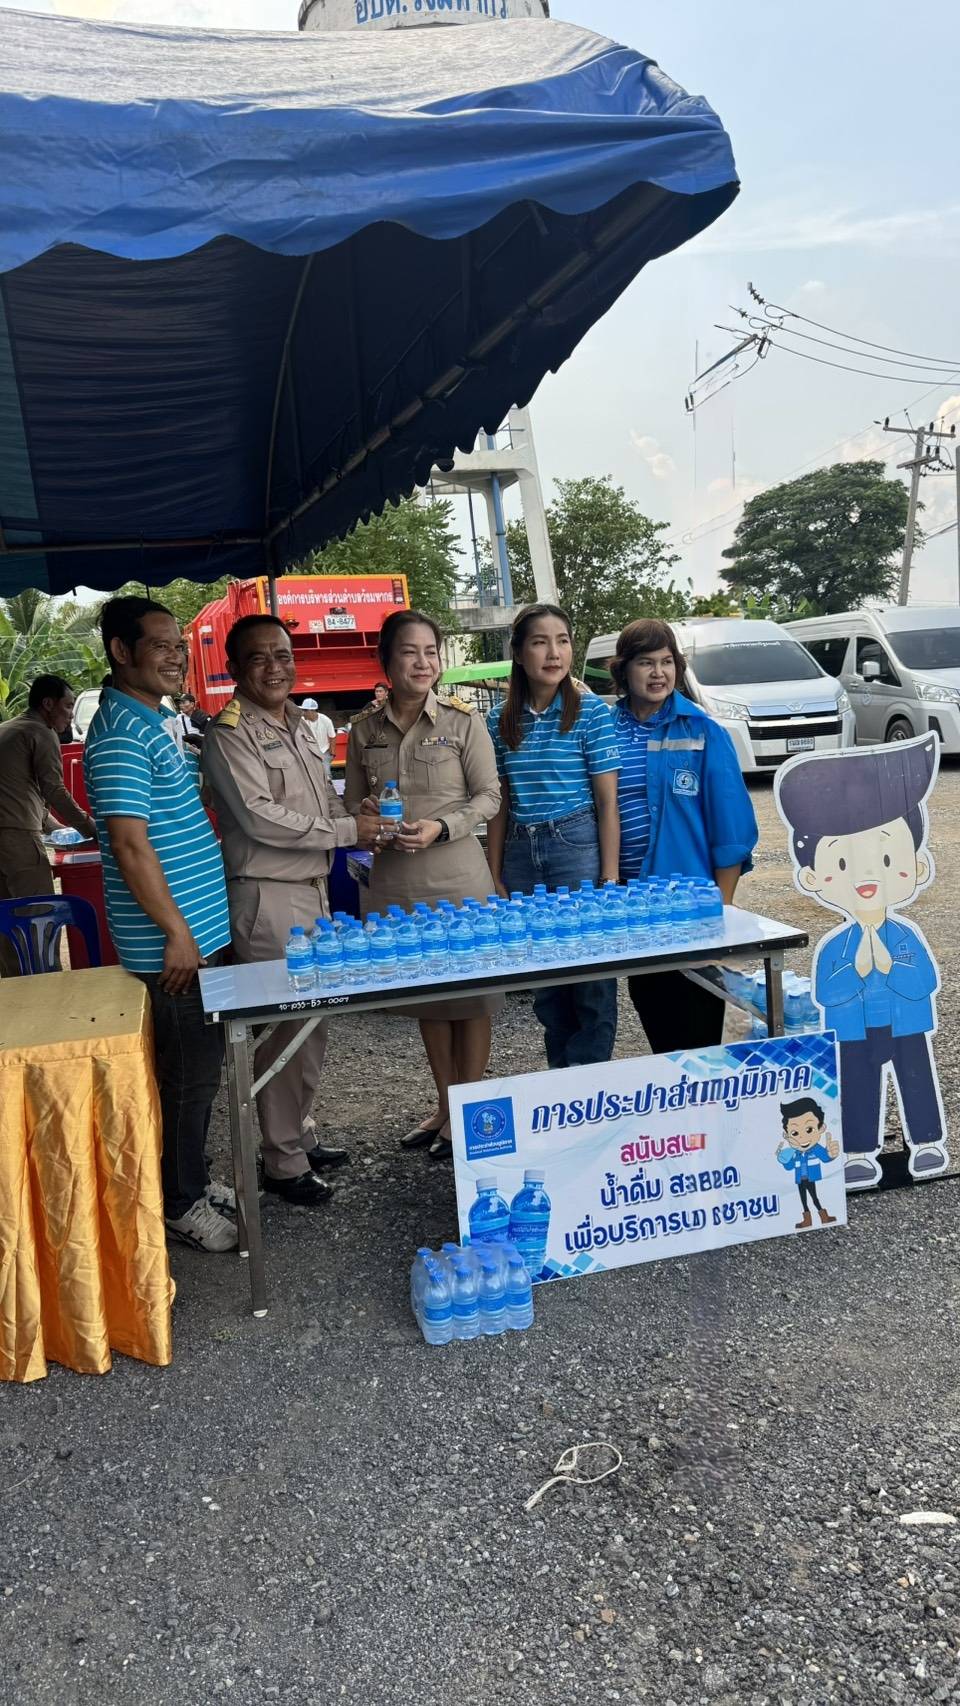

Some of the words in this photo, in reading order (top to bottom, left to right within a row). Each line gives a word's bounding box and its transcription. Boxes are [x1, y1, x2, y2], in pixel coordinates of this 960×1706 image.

[600, 1167, 661, 1208] น้ำดื่ม
[565, 1194, 778, 1252] เพื่อบริการชาชน
